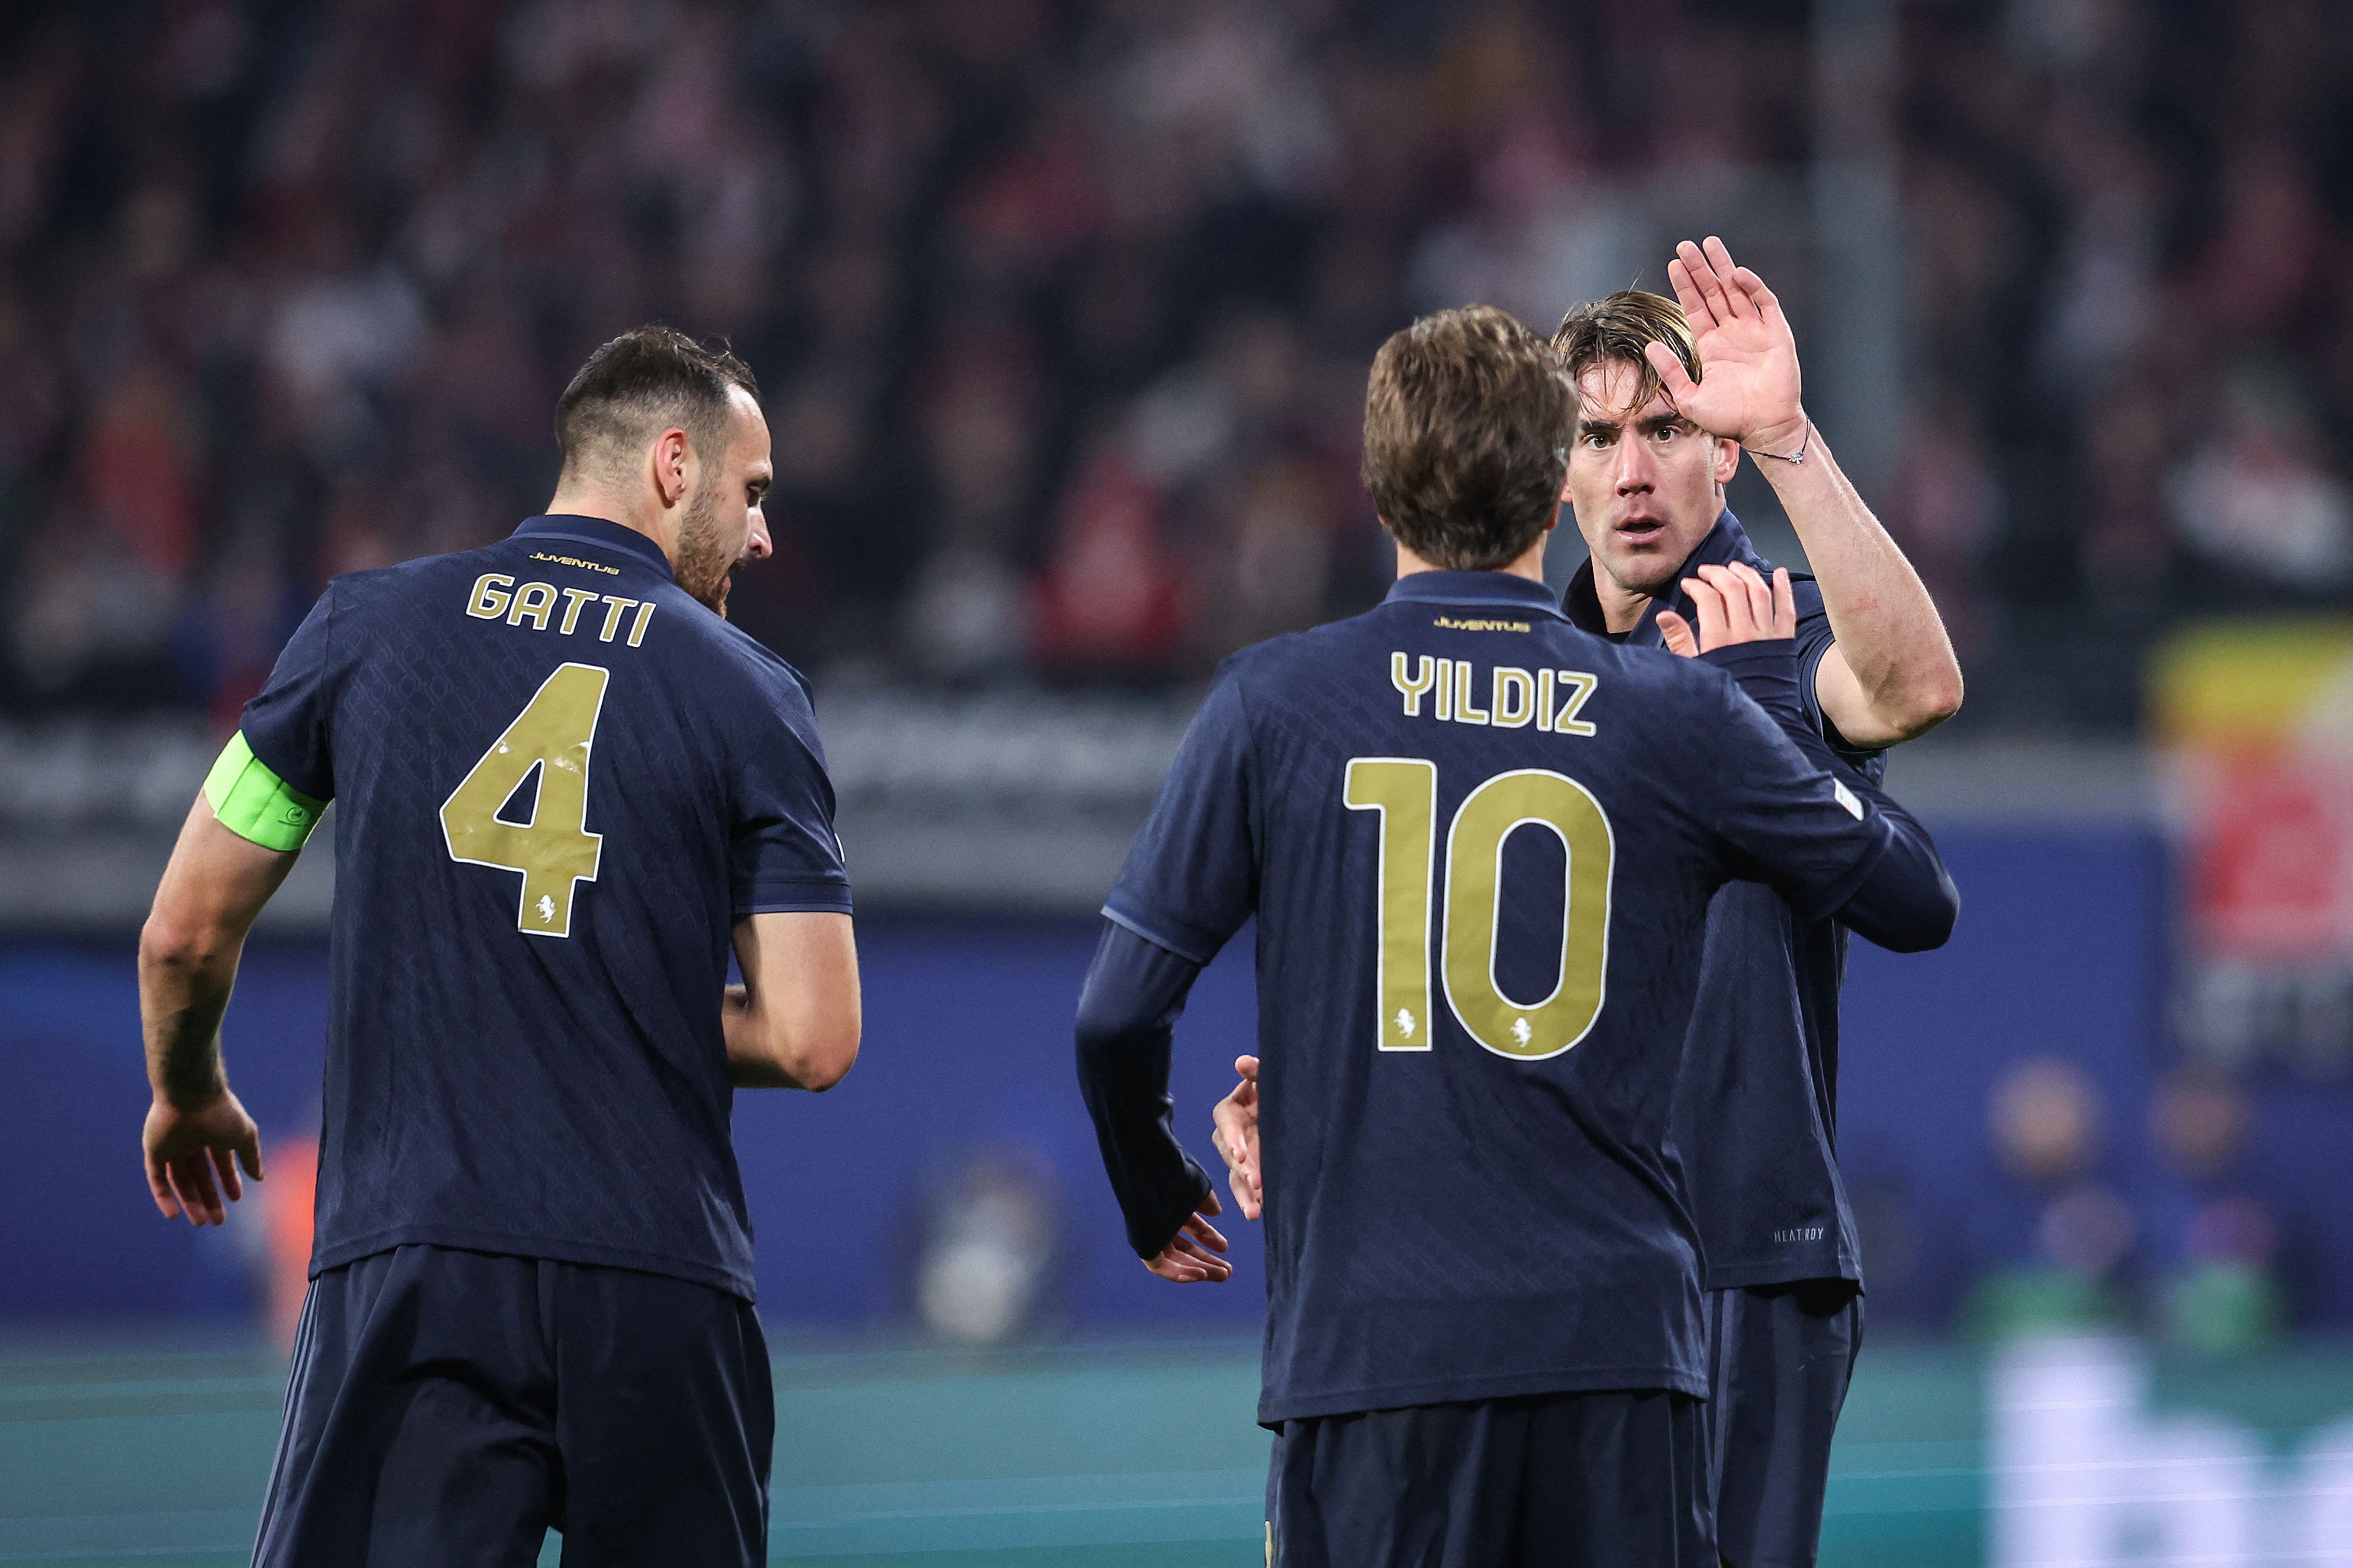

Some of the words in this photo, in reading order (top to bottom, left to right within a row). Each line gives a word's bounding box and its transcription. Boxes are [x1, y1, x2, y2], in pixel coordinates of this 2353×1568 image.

[466, 573, 656, 647] GATTI
[1391, 652, 1598, 737] YILDIZ
[440, 662, 610, 938] 4
[1343, 757, 1615, 1061] 10
